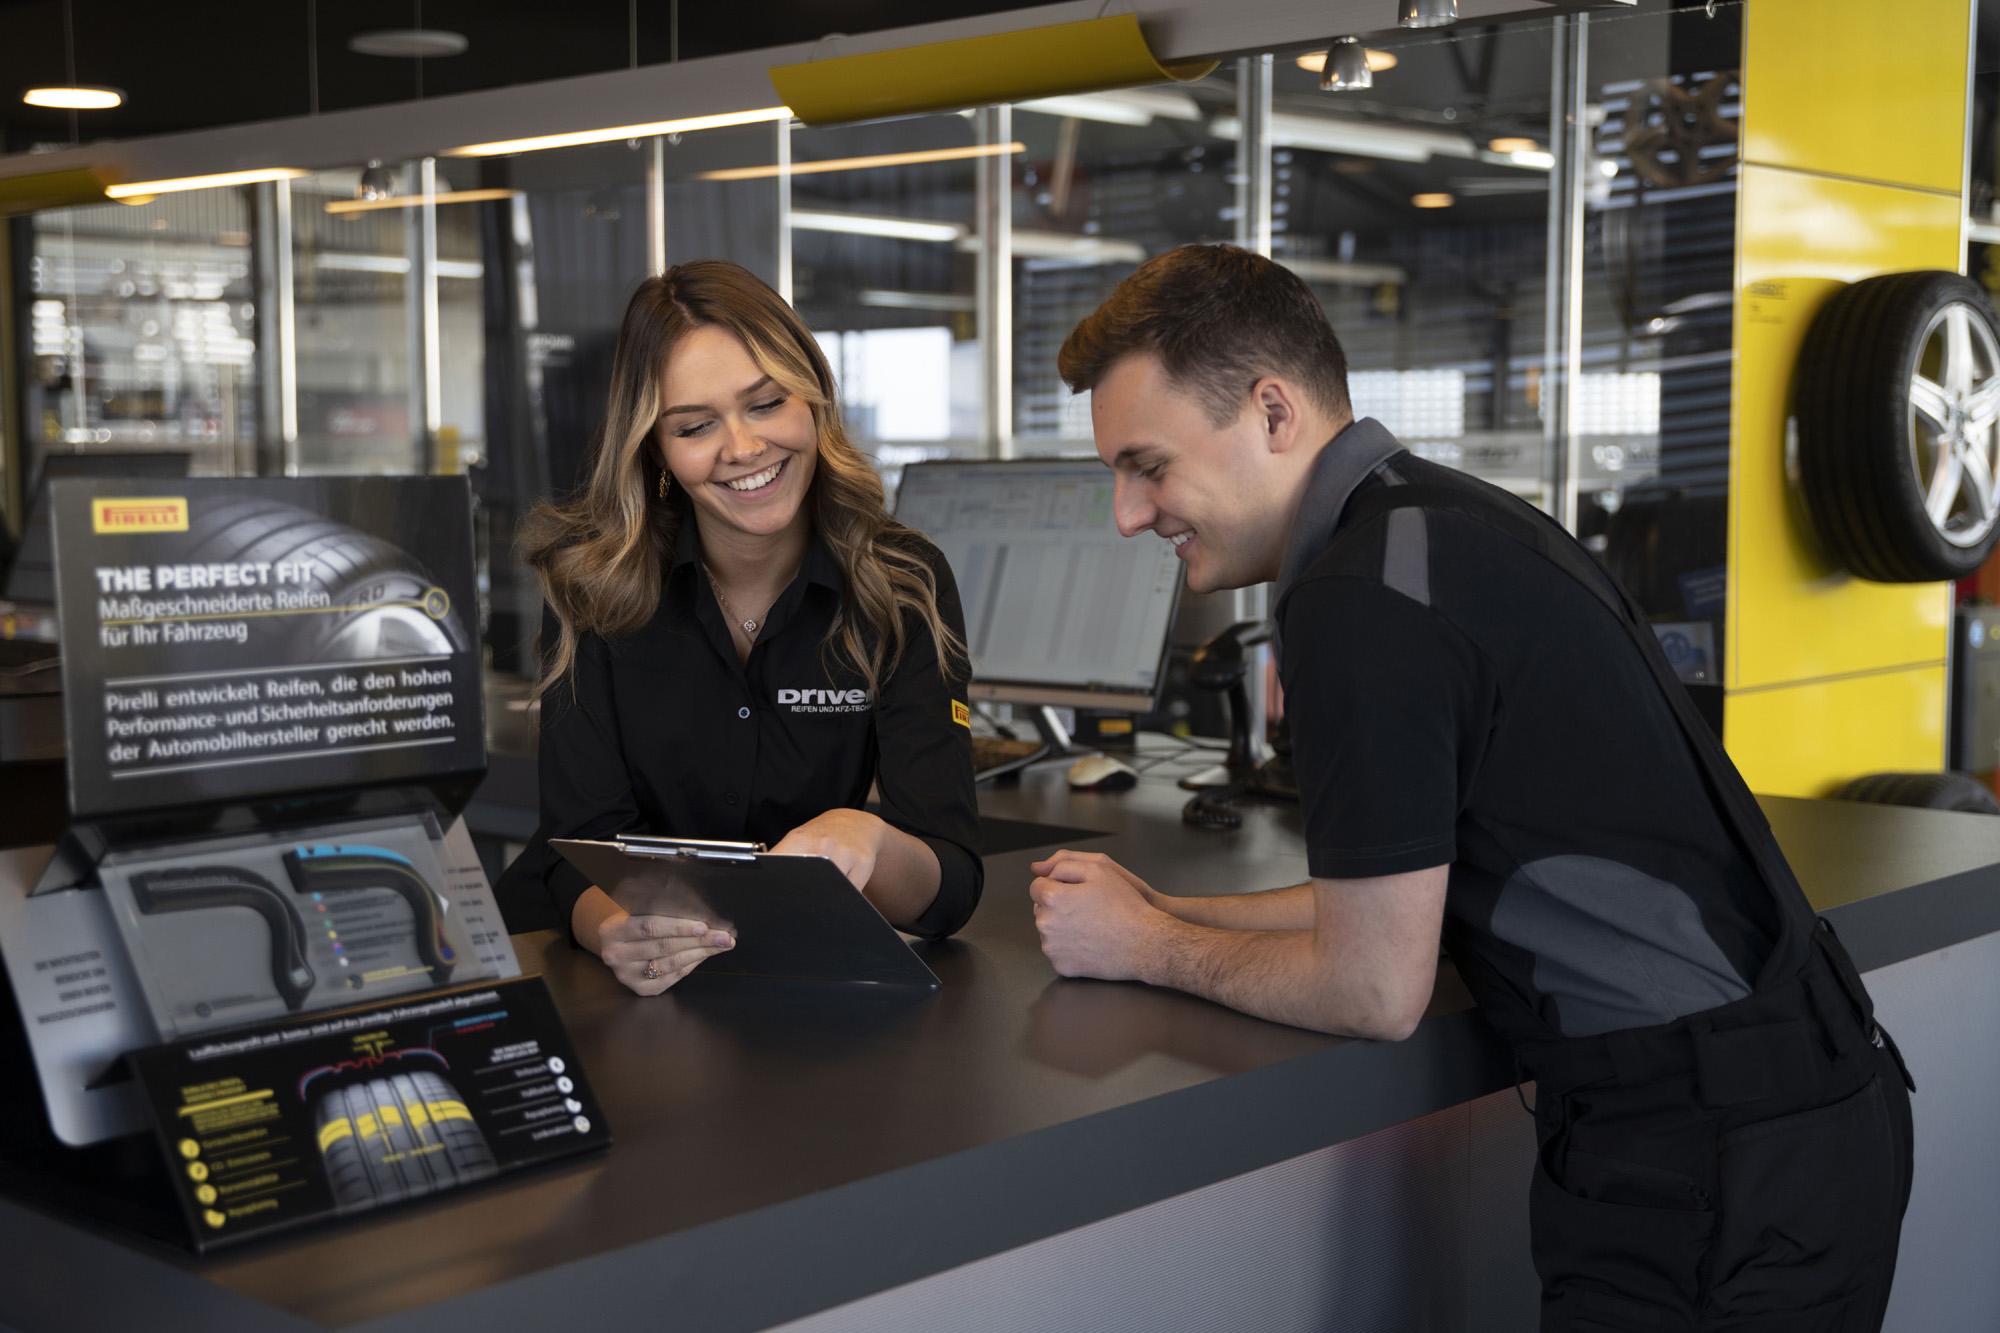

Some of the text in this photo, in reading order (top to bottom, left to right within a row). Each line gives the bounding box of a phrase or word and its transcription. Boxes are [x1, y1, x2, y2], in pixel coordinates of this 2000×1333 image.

[102, 505, 180, 526] PIRELLI
[96, 559, 315, 593] THE PERFECT FIT
[100, 588, 331, 622] Maßgeschneiderte Reifen
[101, 621, 248, 647] für Ihr Fahrzeug
[106, 668, 452, 712] Pirelli entwickelt Reifen, die den hohen
[107, 692, 454, 737] Performance- und Sicherheitsanforderungen
[791, 704, 872, 713] REIFEN UND KFZ-TECH
[109, 713, 456, 763] der Automobilhersteller gerecht werden.
